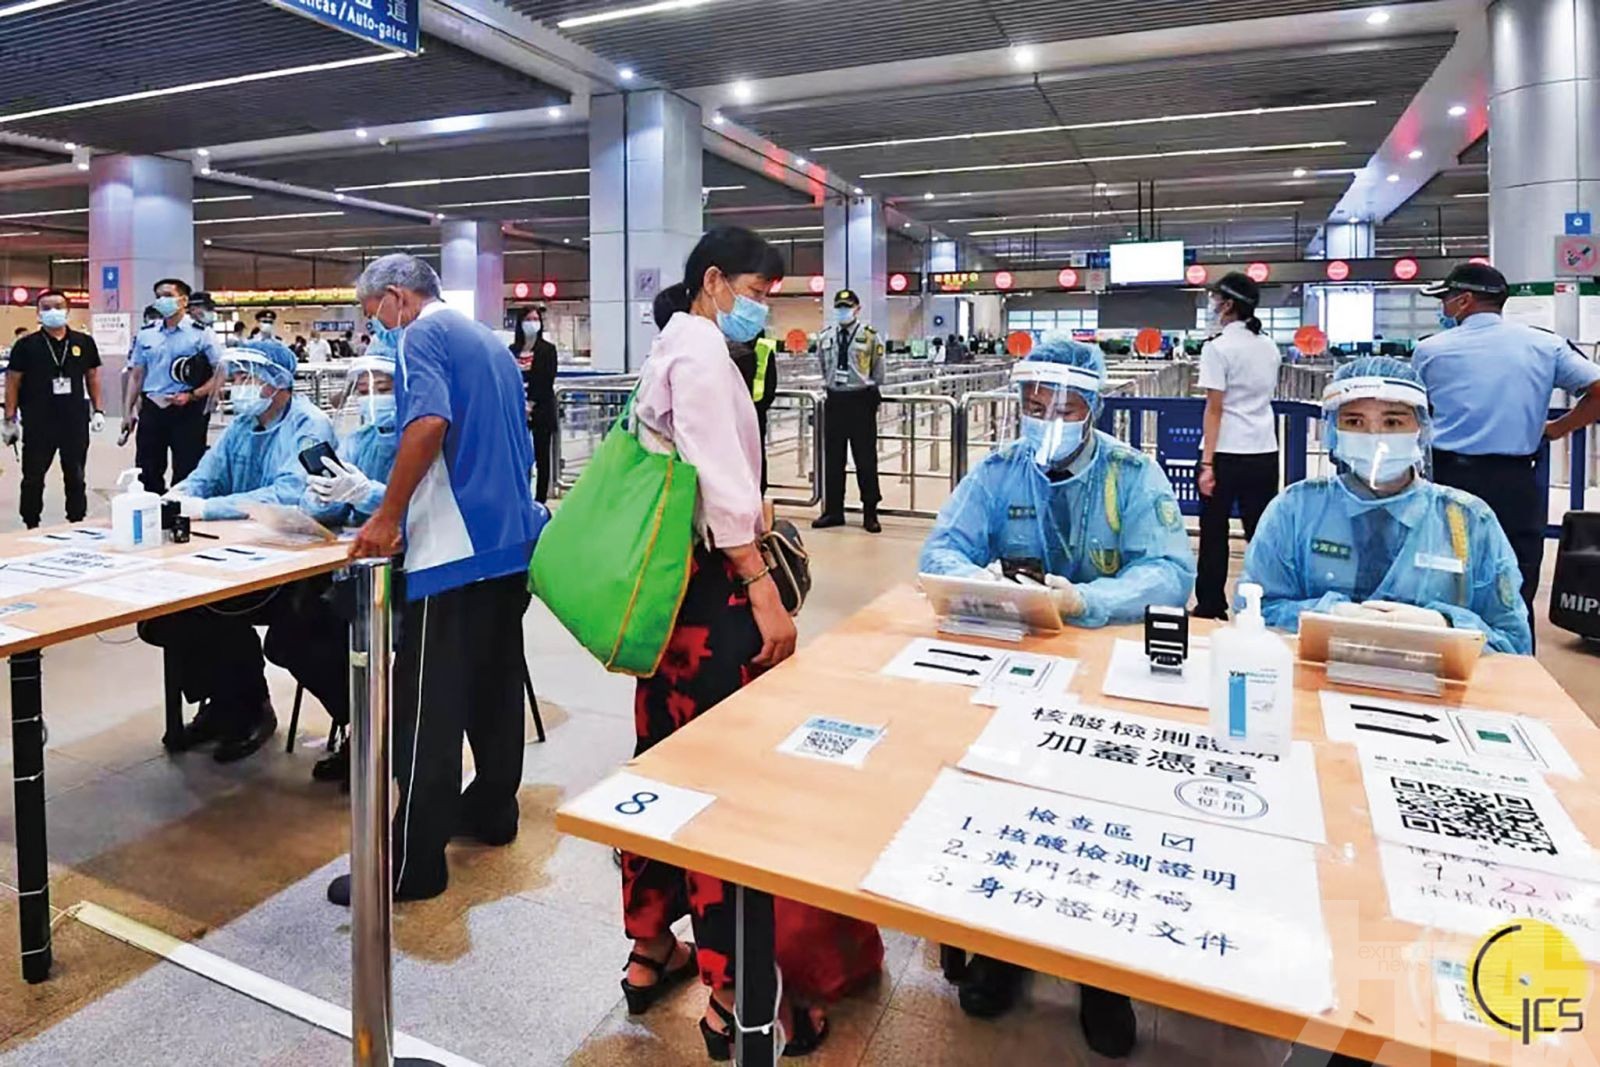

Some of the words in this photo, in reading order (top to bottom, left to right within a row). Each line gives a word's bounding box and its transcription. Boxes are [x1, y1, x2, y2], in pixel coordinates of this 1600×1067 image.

[1560, 592, 1600, 614] MIP
[1037, 730, 1257, 784] 加蓋憑章
[614, 791, 660, 815] 8
[1025, 805, 1134, 841] 檢查區
[997, 823, 1238, 891] 核酸檢測證明
[966, 875, 1240, 956] 身份證明文件
